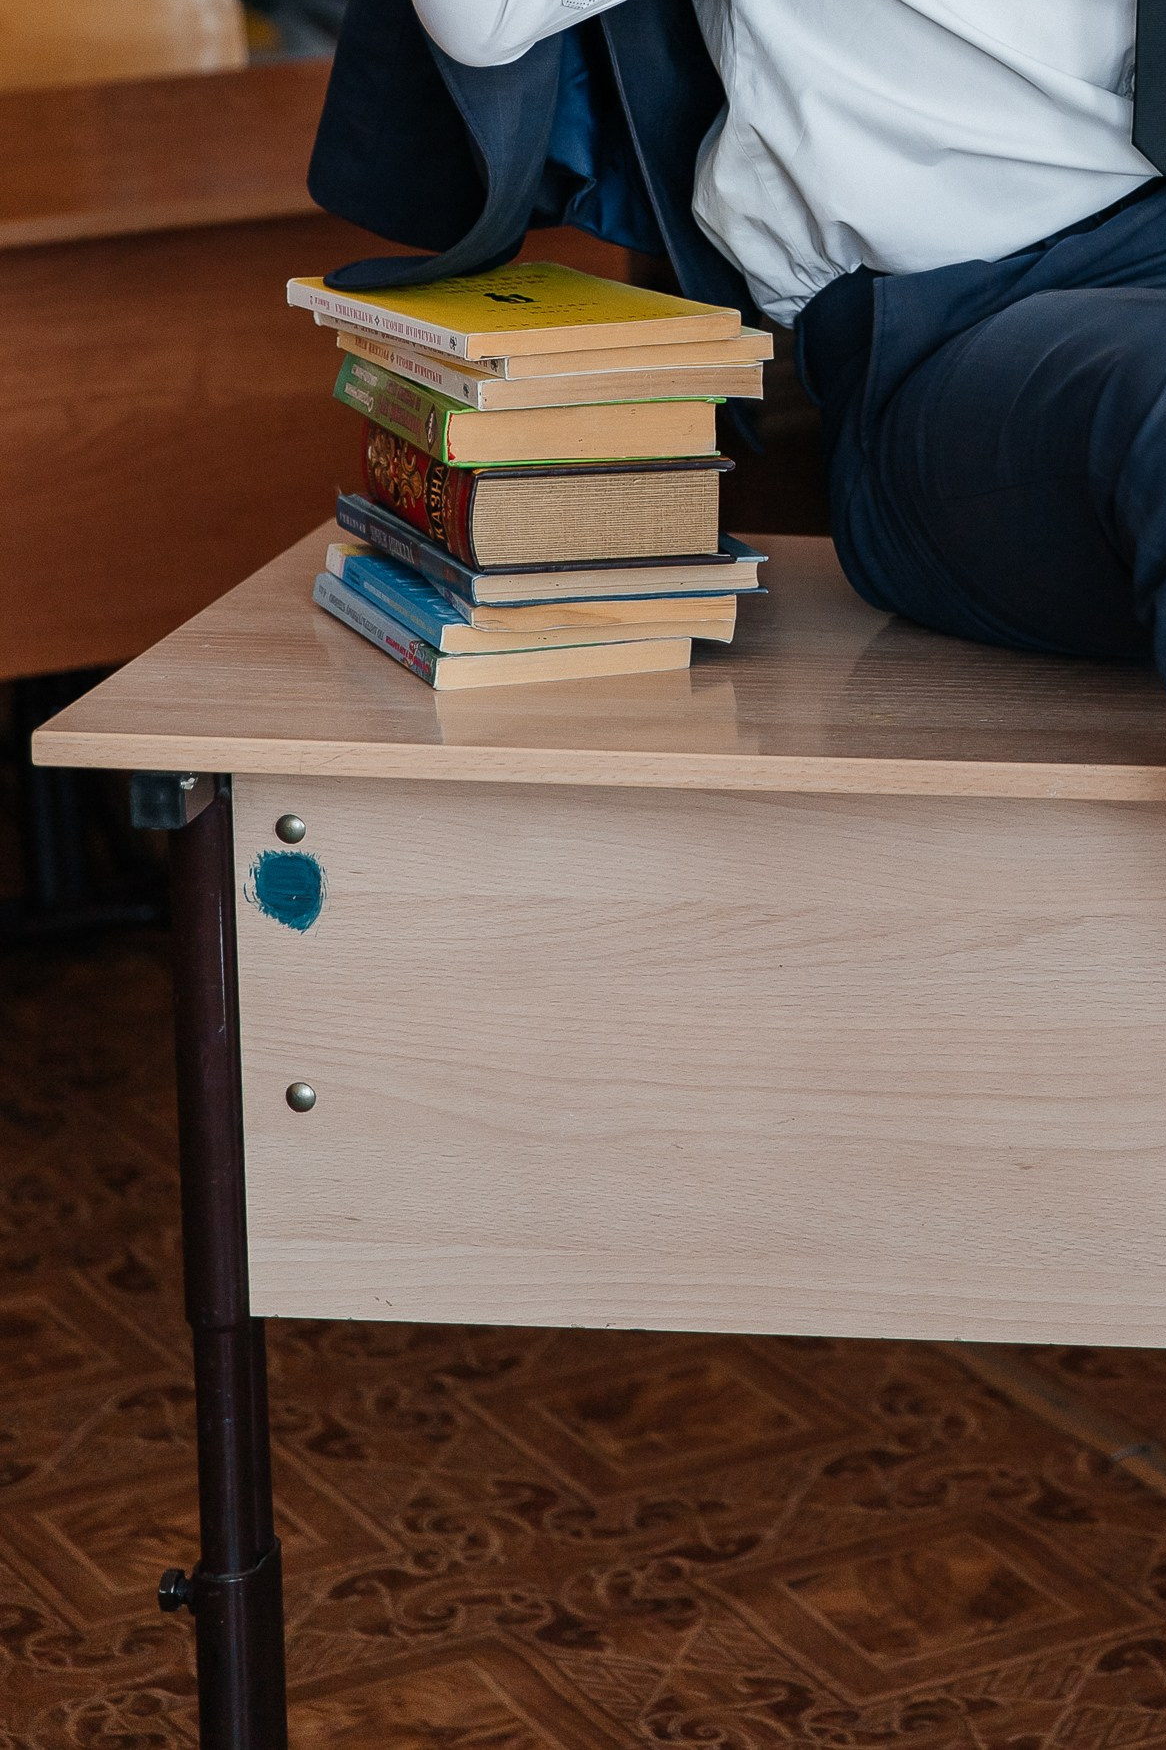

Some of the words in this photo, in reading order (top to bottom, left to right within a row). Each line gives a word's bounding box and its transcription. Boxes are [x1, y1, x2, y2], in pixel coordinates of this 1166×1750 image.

[335, 305, 374, 325] МАТЕМАТИКА
[382, 318, 405, 335] ШКОЛА
[403, 325, 443, 347] НАЧАЛЬНАЯ
[429, 464, 446, 541] КАЗНА
